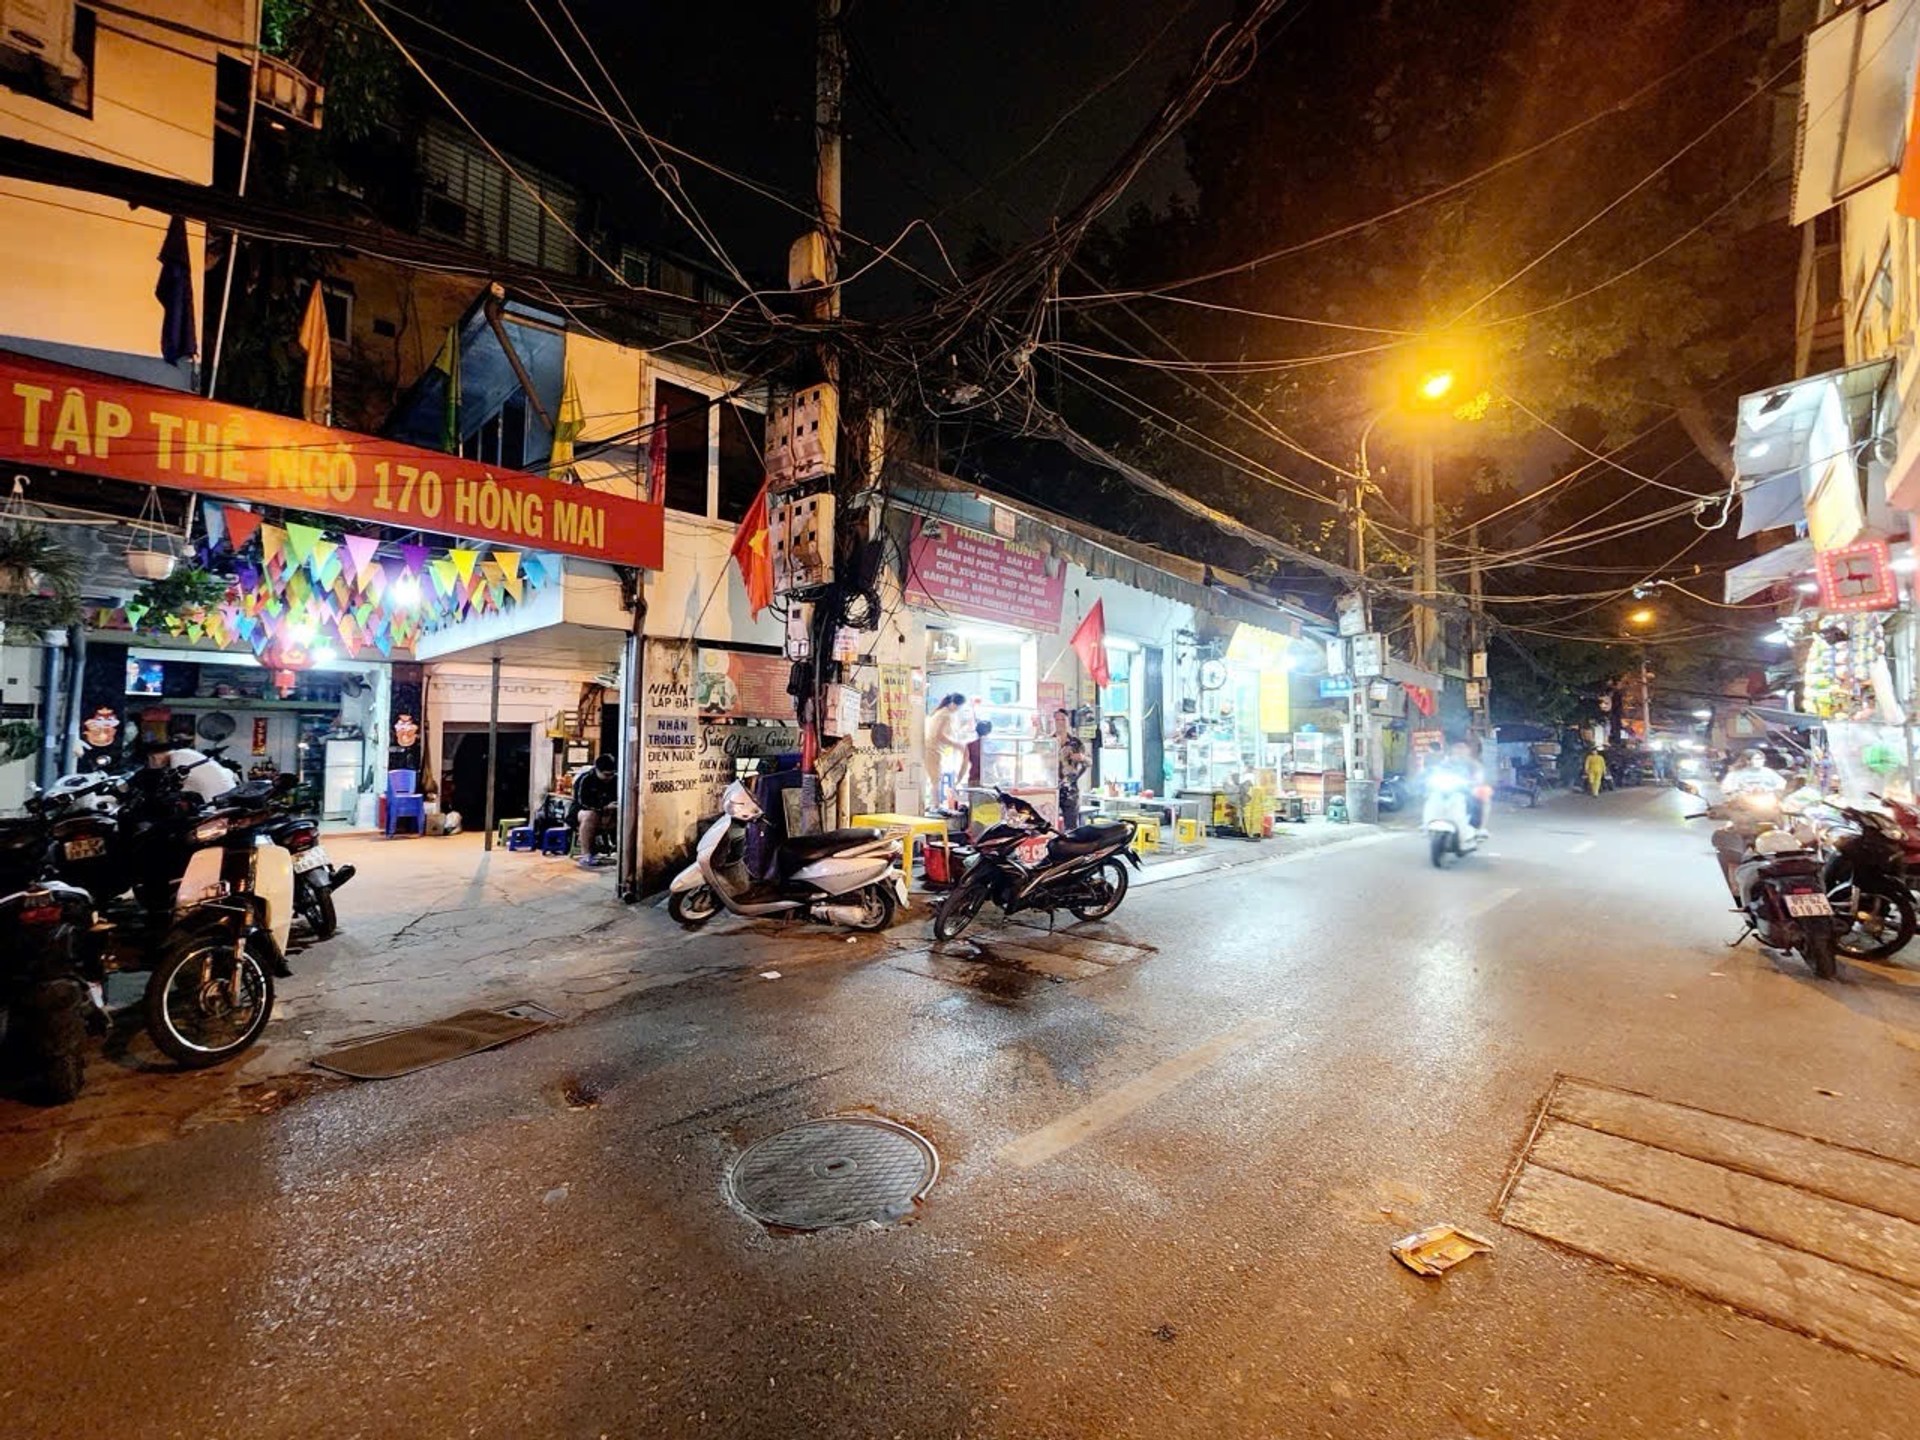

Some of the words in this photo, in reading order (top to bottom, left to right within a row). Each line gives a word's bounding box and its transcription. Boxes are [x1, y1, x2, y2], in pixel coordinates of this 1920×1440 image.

[13, 383, 133, 465] TẬP
[374, 461, 442, 517] 170
[455, 472, 543, 538] HỒNG
[553, 502, 605, 549] MAI
[658, 719, 688, 733] NHẬN
[683, 735, 696, 745] XE
